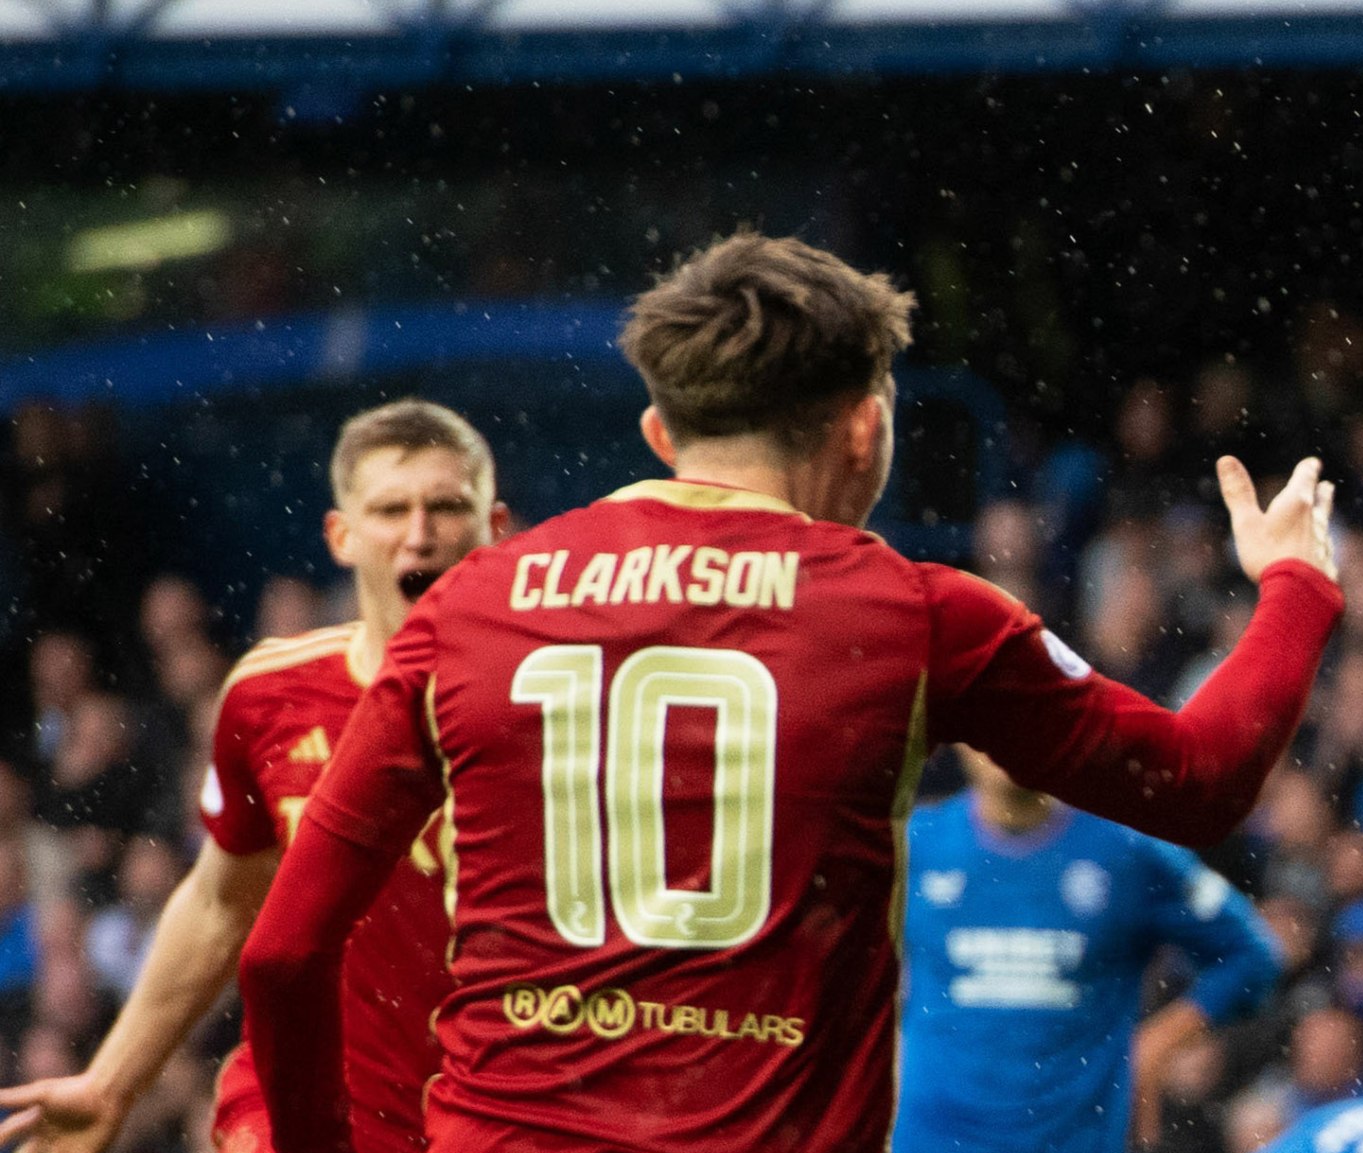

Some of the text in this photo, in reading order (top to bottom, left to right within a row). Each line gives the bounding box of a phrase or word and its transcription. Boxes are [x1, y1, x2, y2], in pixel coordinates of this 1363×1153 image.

[510, 545, 800, 612] CLARKSON
[511, 644, 779, 949] 10
[638, 1001, 805, 1047] TUBULARS
